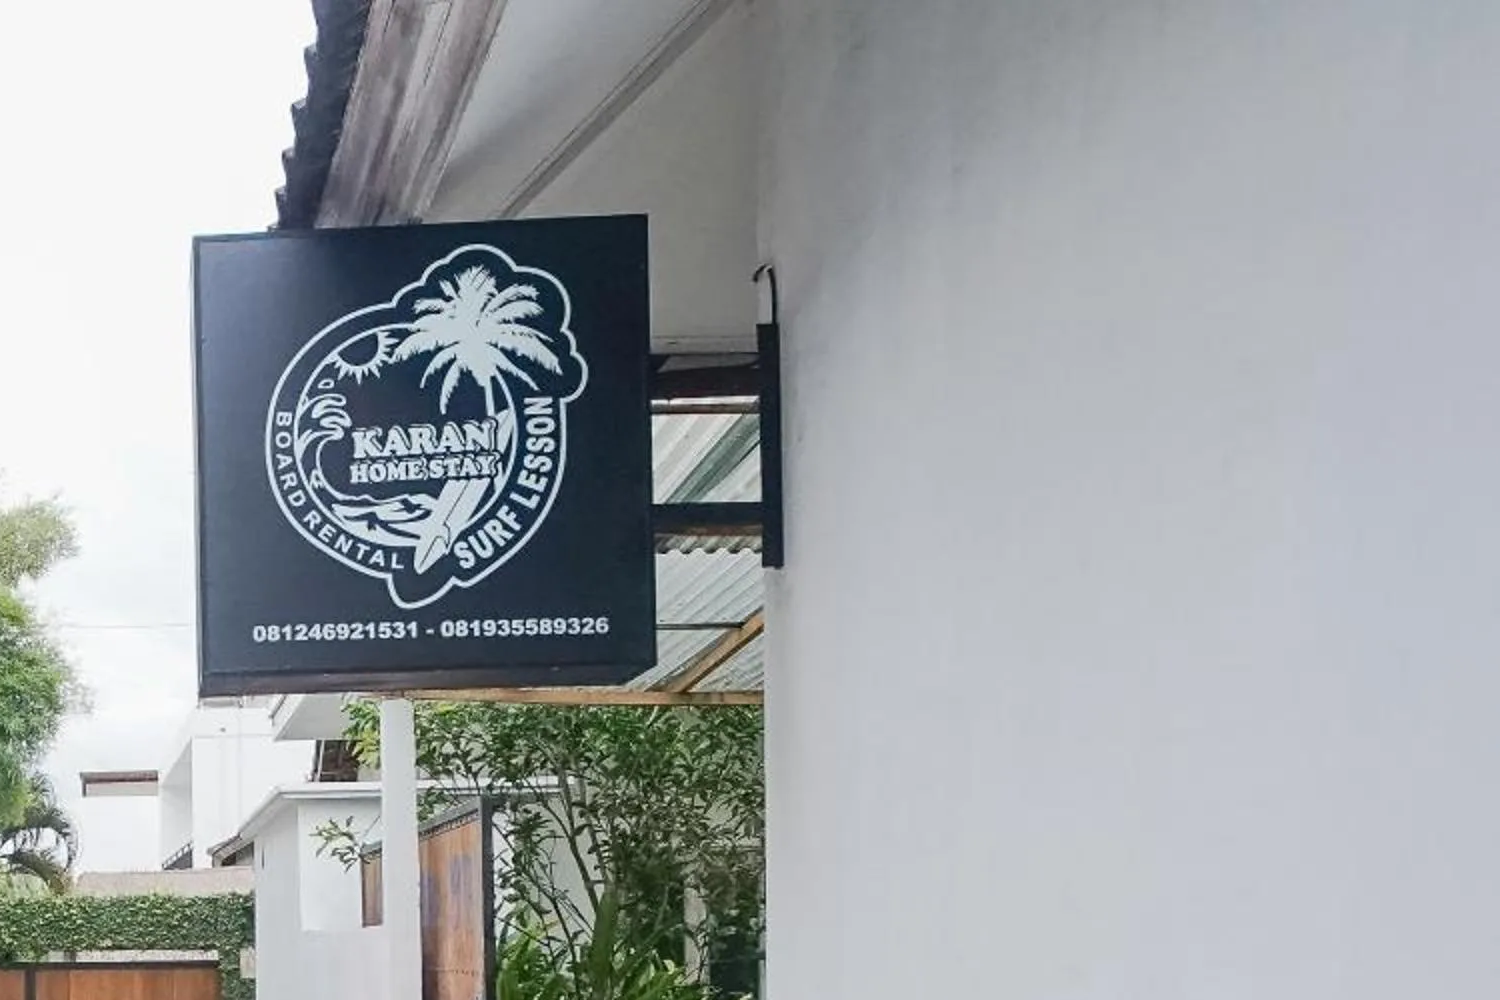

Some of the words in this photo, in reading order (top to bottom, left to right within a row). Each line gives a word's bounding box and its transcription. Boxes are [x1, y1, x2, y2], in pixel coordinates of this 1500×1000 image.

[351, 419, 497, 459] KARAN
[350, 458, 427, 484] HOME
[429, 452, 499, 479] STAY
[453, 505, 522, 569] SURF
[509, 397, 556, 509] LESSON
[275, 411, 306, 507] BOARD
[303, 510, 404, 569] RENTAL
[252, 621, 418, 642] 081246921531
[440, 617, 610, 638] 081935589326
